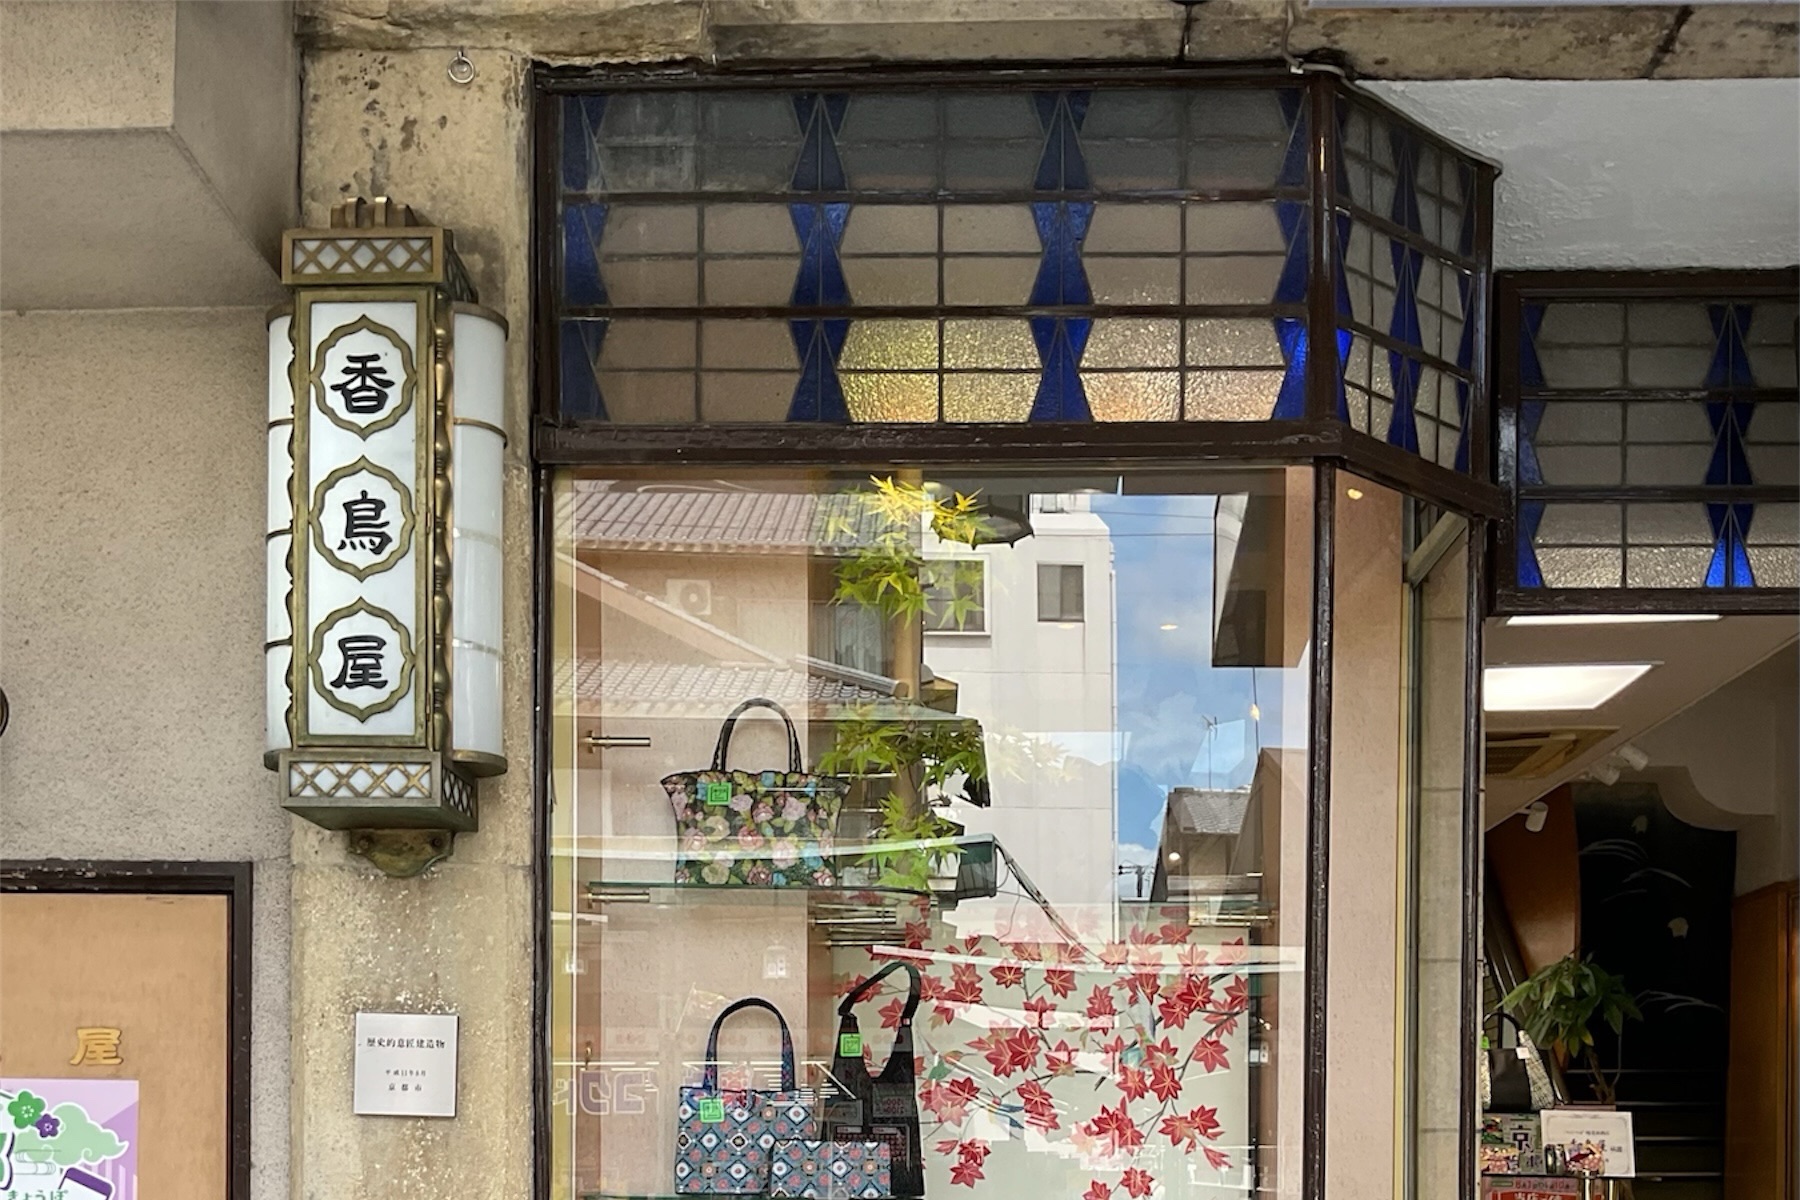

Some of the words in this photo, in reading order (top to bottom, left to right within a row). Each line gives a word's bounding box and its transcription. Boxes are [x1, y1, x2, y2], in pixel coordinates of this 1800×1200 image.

[329, 352, 395, 690] 香鳥屋
[69, 1027, 124, 1066] 屋
